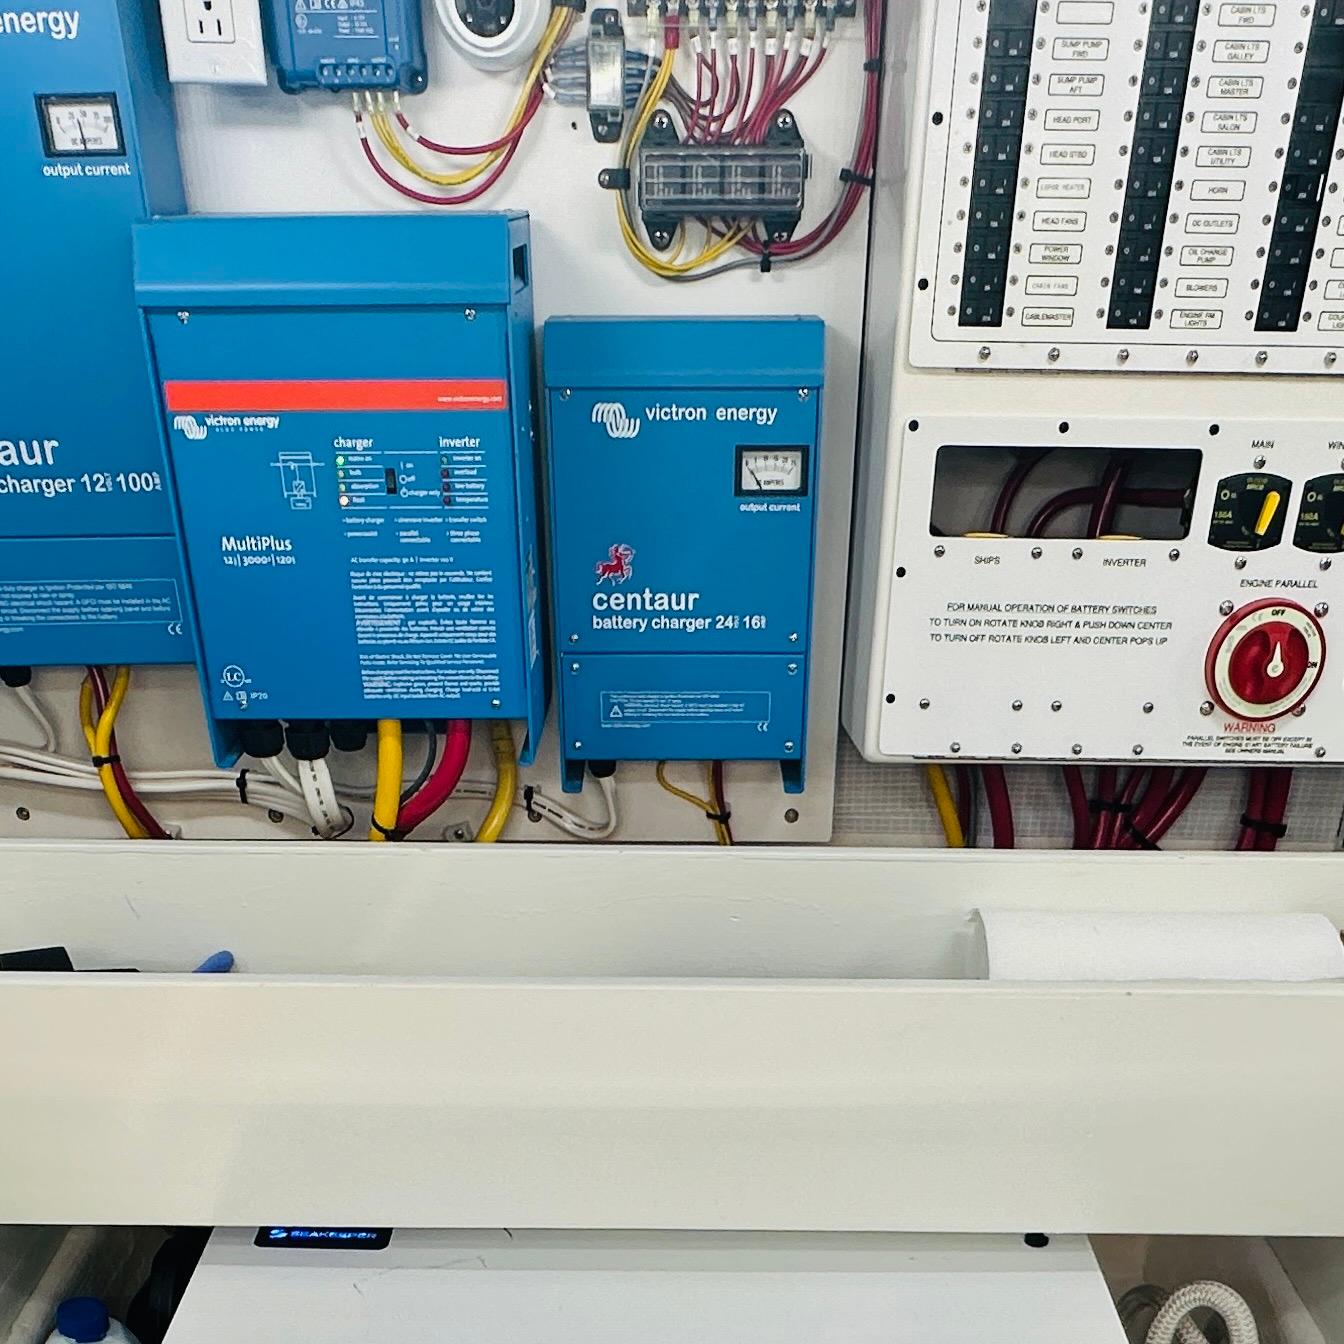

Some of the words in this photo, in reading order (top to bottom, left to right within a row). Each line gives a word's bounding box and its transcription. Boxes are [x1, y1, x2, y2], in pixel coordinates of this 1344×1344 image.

[1083, 41, 1103, 49] PUMP
[43, 163, 83, 178] output
[85, 163, 131, 176] current
[646, 404, 706, 421] victron
[716, 406, 778, 425] energy
[205, 414, 241, 426] victron
[243, 416, 280, 429] energy
[334, 437, 373, 450] charger
[439, 436, 481, 448] inverter
[1251, 440, 1274, 450] MAIN
[740, 503, 767, 513] output
[769, 503, 801, 512] current
[222, 535, 292, 551] MultiPlus
[974, 556, 1000, 565] SHIPS
[1103, 558, 1147, 568] INVERTER
[1240, 579, 1272, 589] ENGINE
[1275, 579, 1319, 589] PARALLEL
[592, 588, 699, 611] centaur
[947, 602, 965, 612] FOR
[967, 603, 1002, 612] MANUAL
[1005, 604, 1054, 613] OPERATION
[1057, 604, 1069, 613] OF
[1071, 605, 1109, 615] BATTERY
[1112, 606, 1158, 615] SWITCHES
[592, 615, 648, 632] battery
[651, 615, 711, 632] charger
[929, 618, 942, 626] TO
[944, 618, 967, 627] TURN
[969, 619, 981, 627] ON
[983, 619, 1018, 628] ROTATE
[1020, 620, 1044, 628] KNOB
[1046, 620, 1073, 629] RIGHT
[1083, 621, 1107, 629] PUSH
[1108, 621, 1135, 629] DOWN
[1137, 622, 1172, 630] CENTER
[930, 634, 942, 642] TO
[944, 634, 968, 642] TURN
[969, 634, 986, 643] OFF
[988, 635, 1023, 643] ROTATE
[1024, 635, 1049, 644] KNOB
[1051, 635, 1071, 644] LEFT
[1073, 636, 1091, 644] AND
[1093, 636, 1128, 645] CENTER
[1129, 637, 1154, 645] POPS
[1156, 637, 1168, 645] UP
[1224, 722, 1276, 733] WARNING
